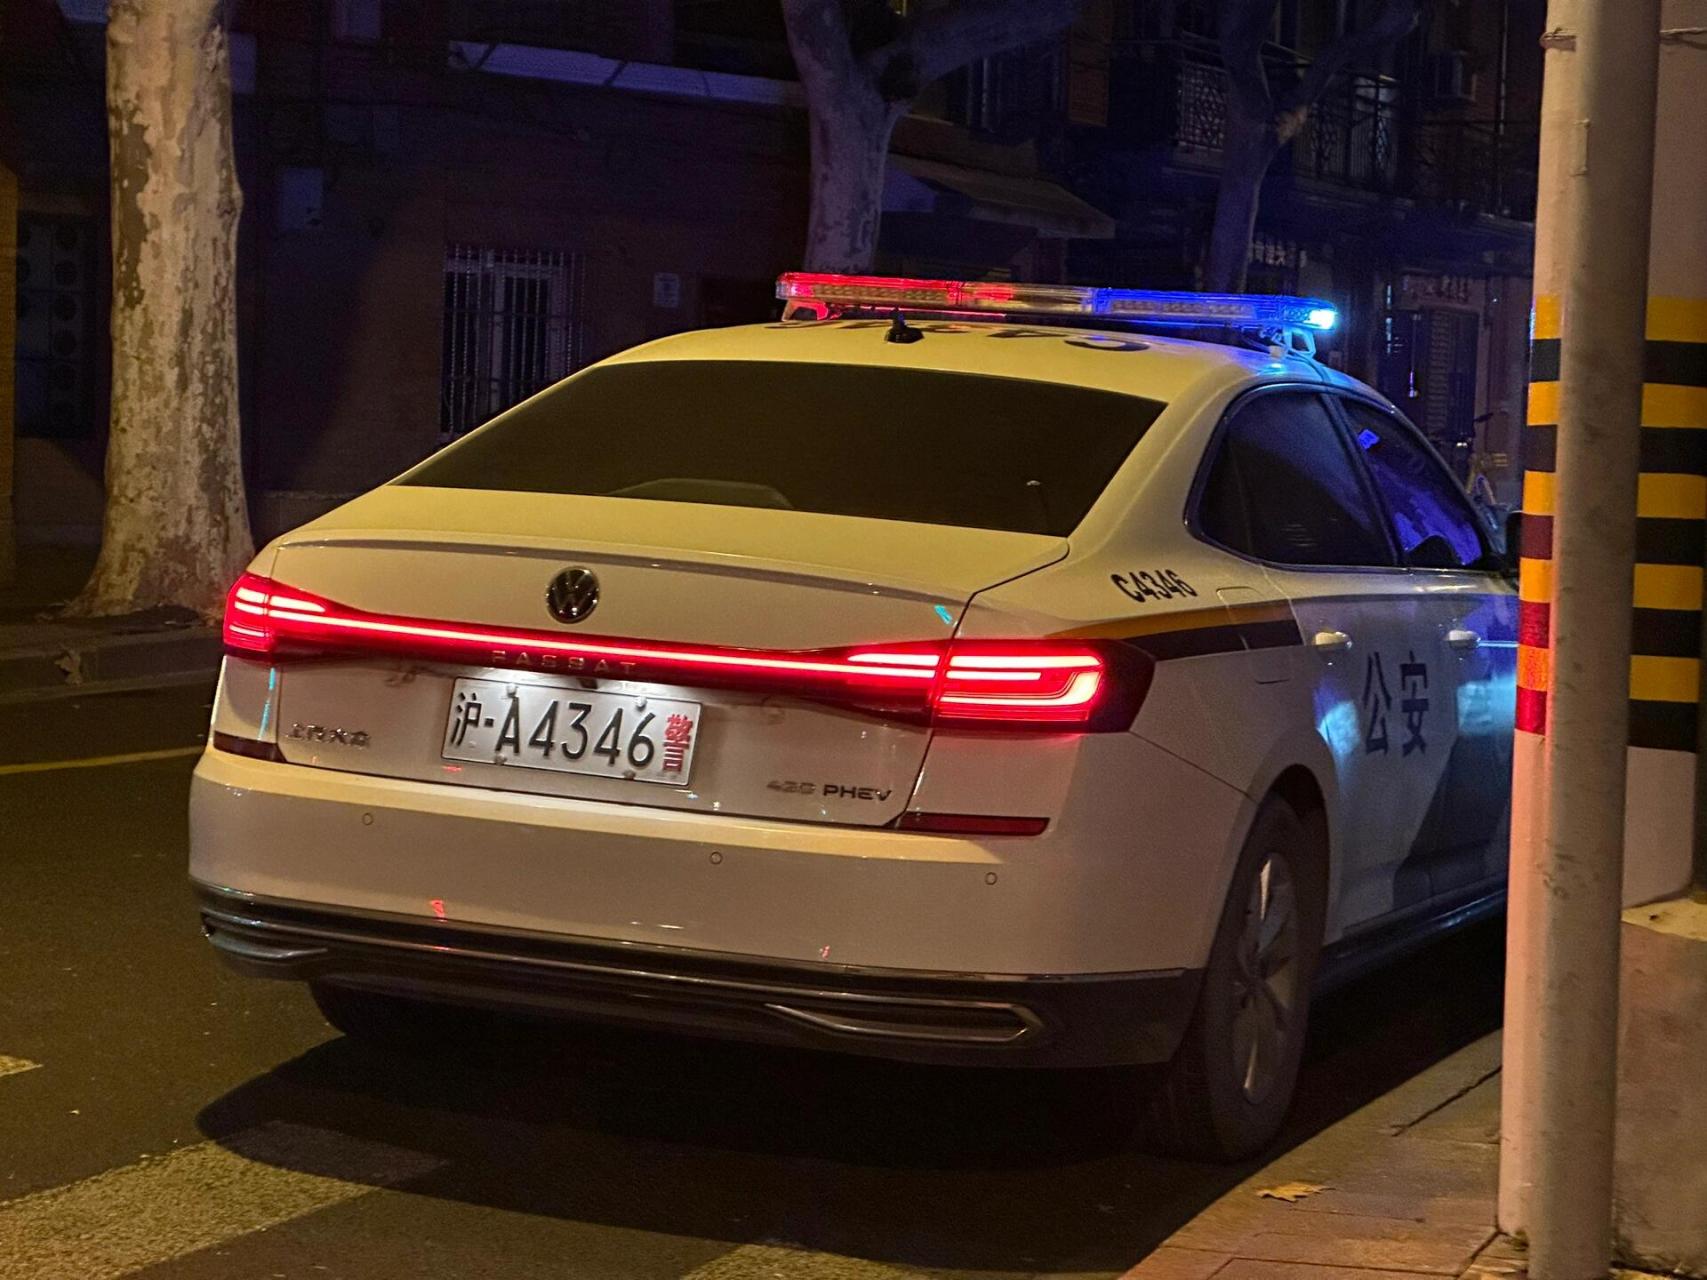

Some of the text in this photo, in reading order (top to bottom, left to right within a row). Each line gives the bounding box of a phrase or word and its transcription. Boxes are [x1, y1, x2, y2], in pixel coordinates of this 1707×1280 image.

[1110, 568, 1199, 603] C4346
[490, 650, 637, 675] PASSAT
[1361, 650, 1430, 757] 公安
[823, 784, 892, 802] PHEV
